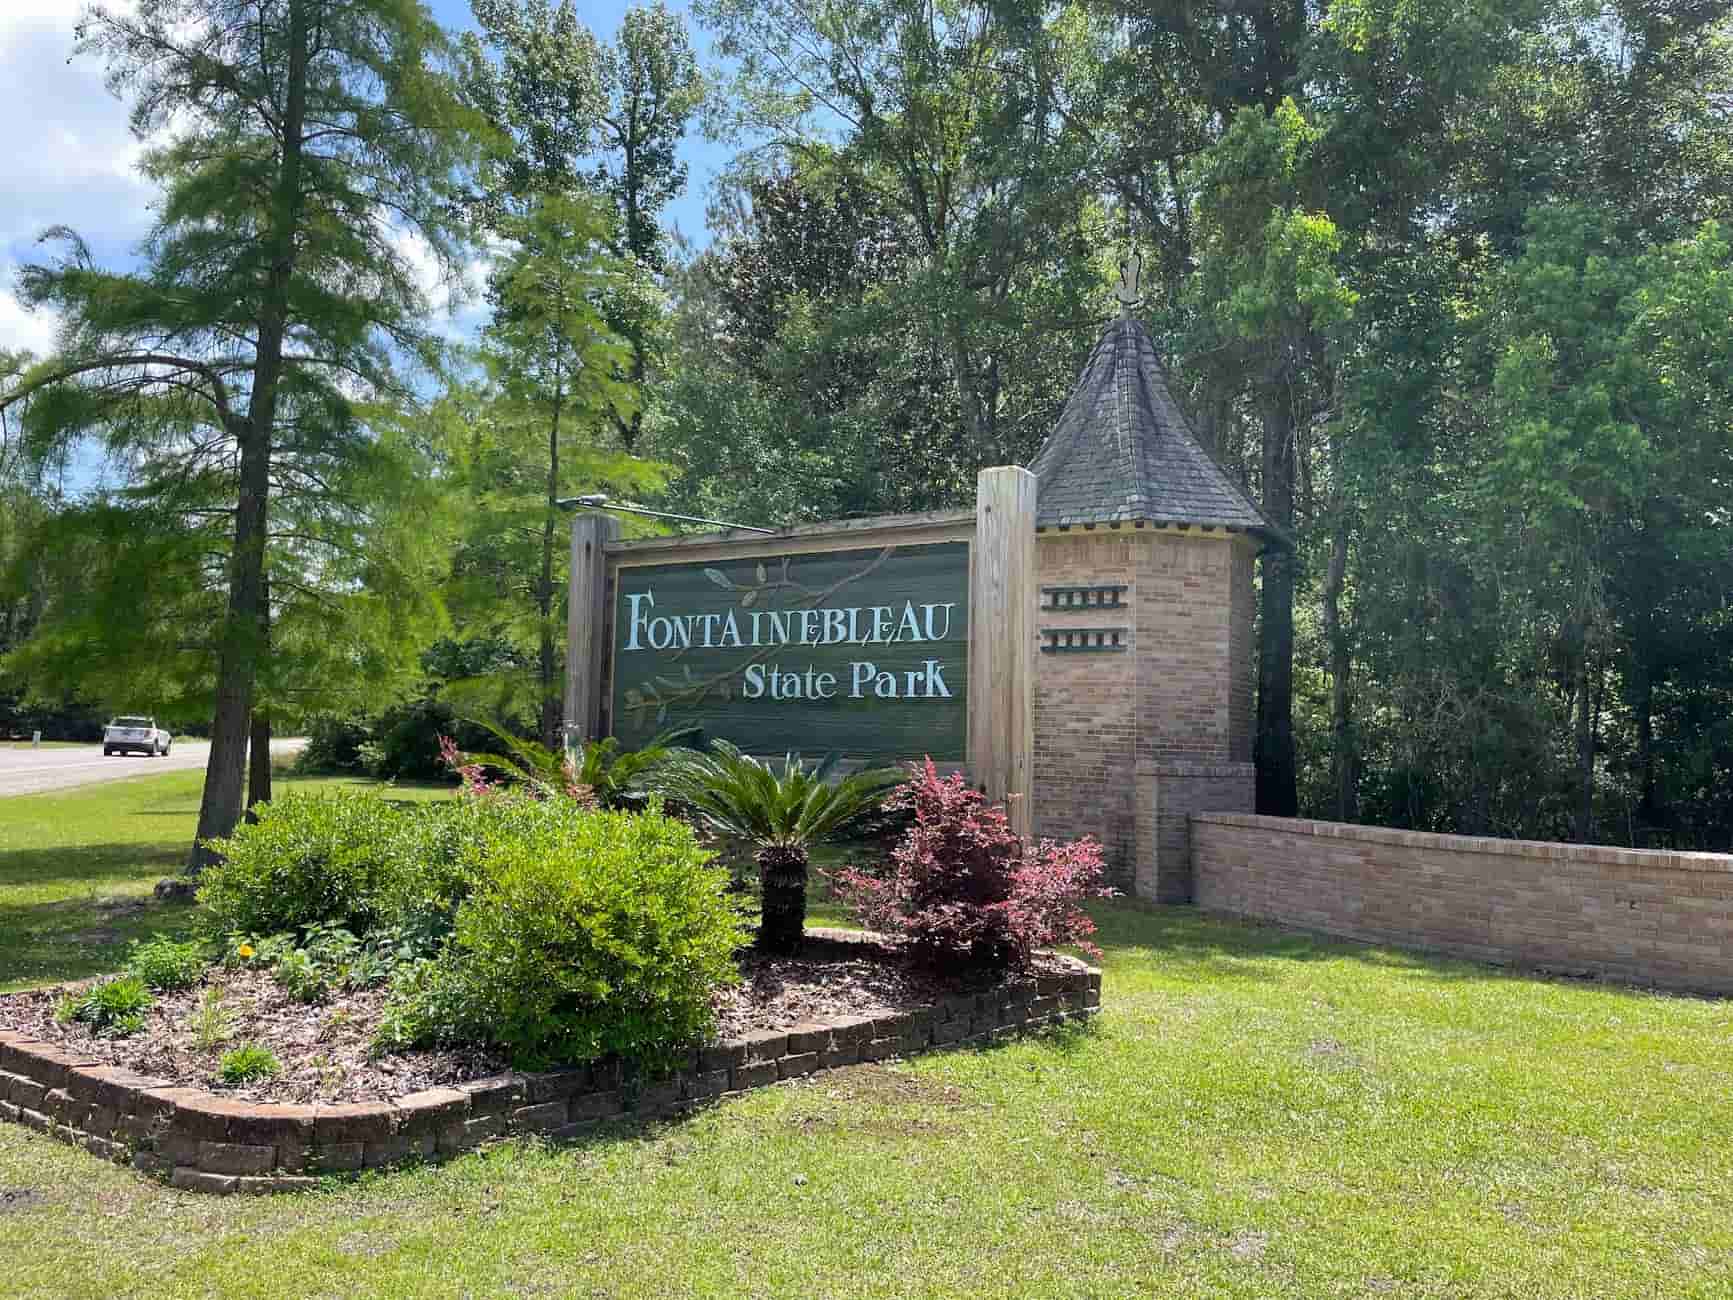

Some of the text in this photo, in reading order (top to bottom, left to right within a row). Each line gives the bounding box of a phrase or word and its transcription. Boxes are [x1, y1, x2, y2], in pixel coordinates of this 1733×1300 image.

[624, 587, 956, 650] FONTAINEBLEAU
[743, 659, 953, 700] State Park
